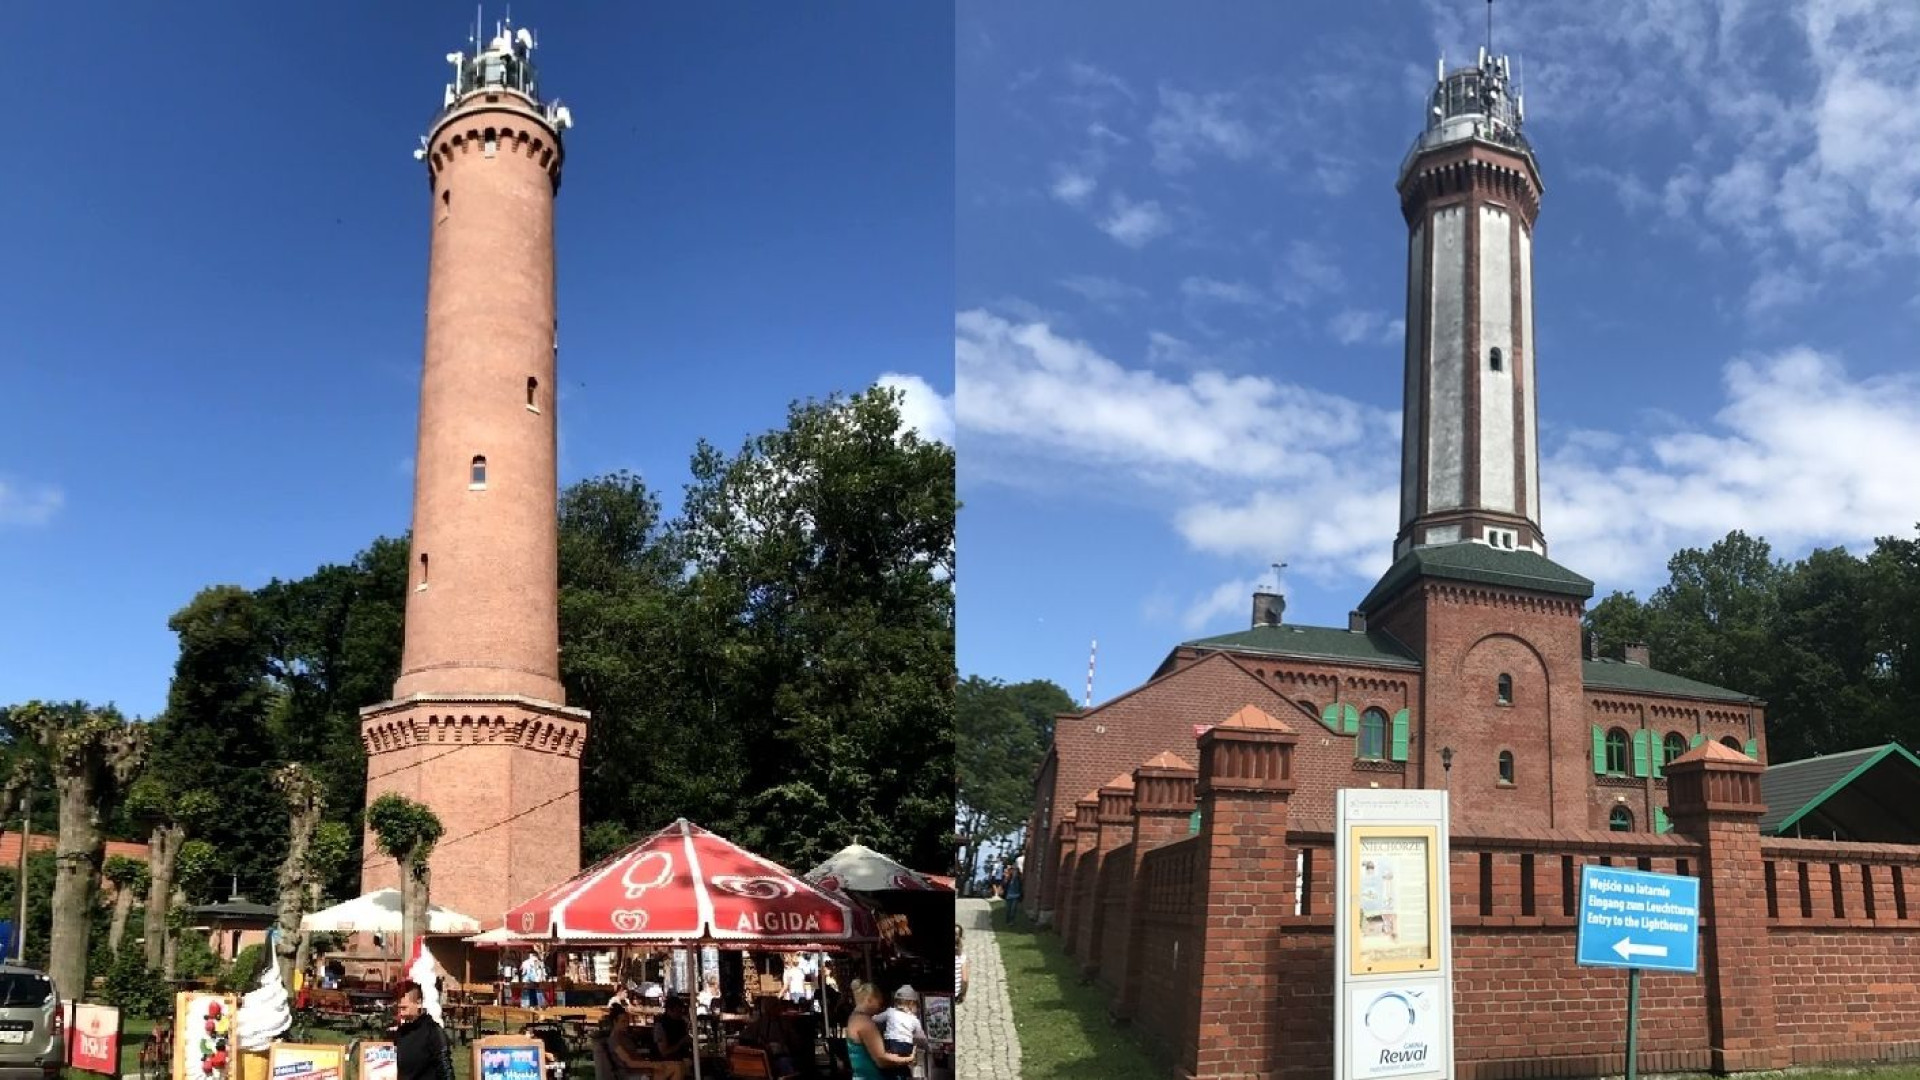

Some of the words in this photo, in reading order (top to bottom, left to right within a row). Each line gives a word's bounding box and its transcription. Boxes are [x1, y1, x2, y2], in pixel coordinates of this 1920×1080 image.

[1362, 841, 1421, 851] NIECHORZE
[1589, 878, 1622, 893] Wejście
[1623, 884, 1635, 894] na
[1588, 894, 1625, 912] Eingang
[1626, 901, 1645, 911] zum
[1646, 900, 1696, 916] Leuchtturm
[736, 911, 820, 930] ALGIDA
[1587, 912, 1612, 927] Entry
[1614, 915, 1623, 925] to
[1625, 915, 1639, 927] the
[1642, 917, 1688, 932] Lighthouse
[1379, 1044, 1428, 1065] Rewal
